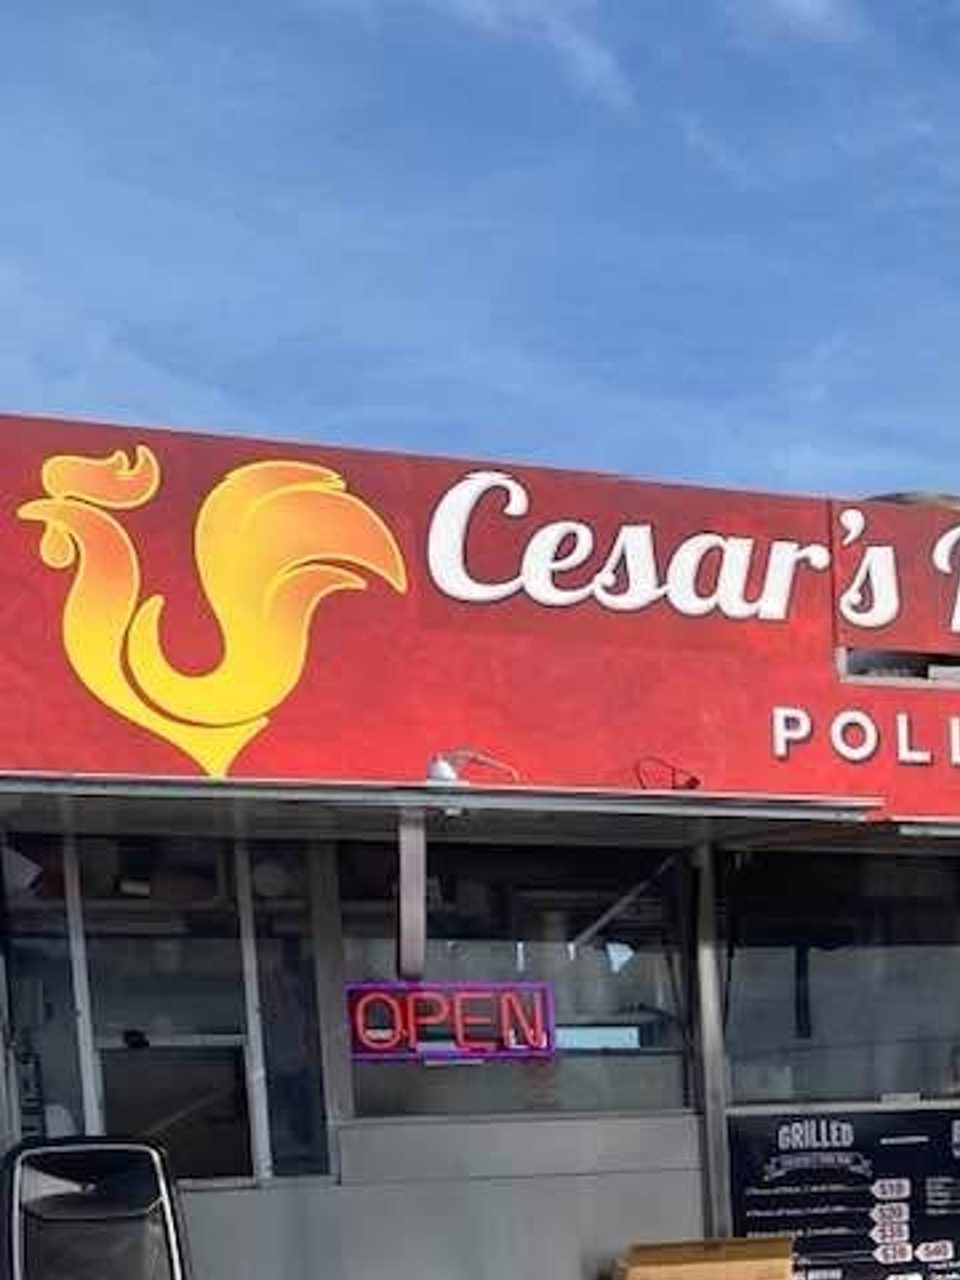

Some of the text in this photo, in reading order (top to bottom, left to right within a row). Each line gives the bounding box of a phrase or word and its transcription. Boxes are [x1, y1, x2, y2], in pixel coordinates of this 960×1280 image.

[426, 470, 899, 628] Cesar's
[356, 991, 548, 1049] OPEN
[777, 1119, 854, 1150] GRILLED
